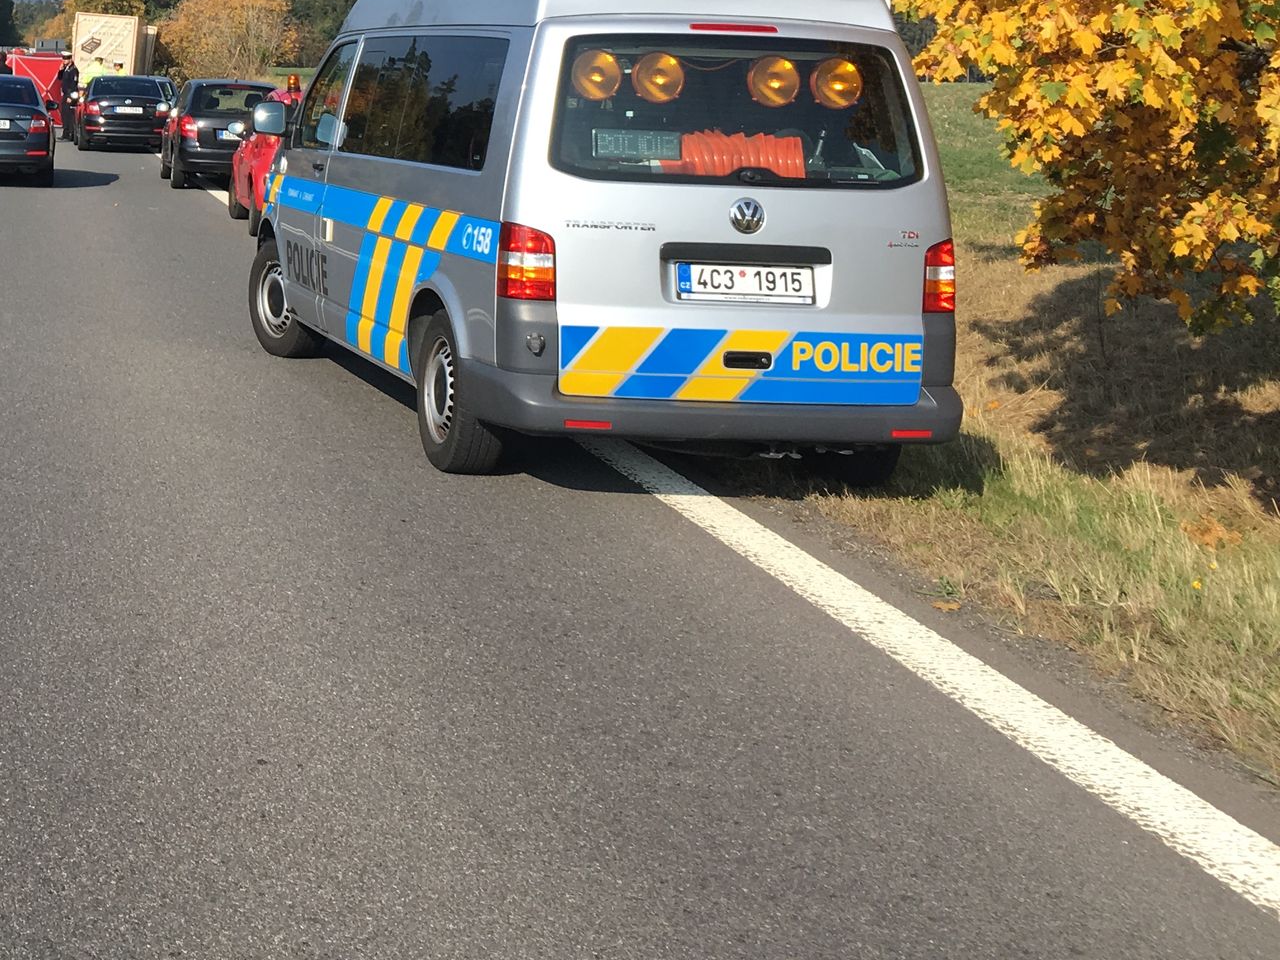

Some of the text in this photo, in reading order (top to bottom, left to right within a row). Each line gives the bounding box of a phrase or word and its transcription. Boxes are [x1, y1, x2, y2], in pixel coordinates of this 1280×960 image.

[473, 226, 493, 254] 158
[287, 240, 328, 296] POLICIE
[680, 268, 802, 292] CZ 4C3 1915
[792, 341, 922, 373] POLICIE
